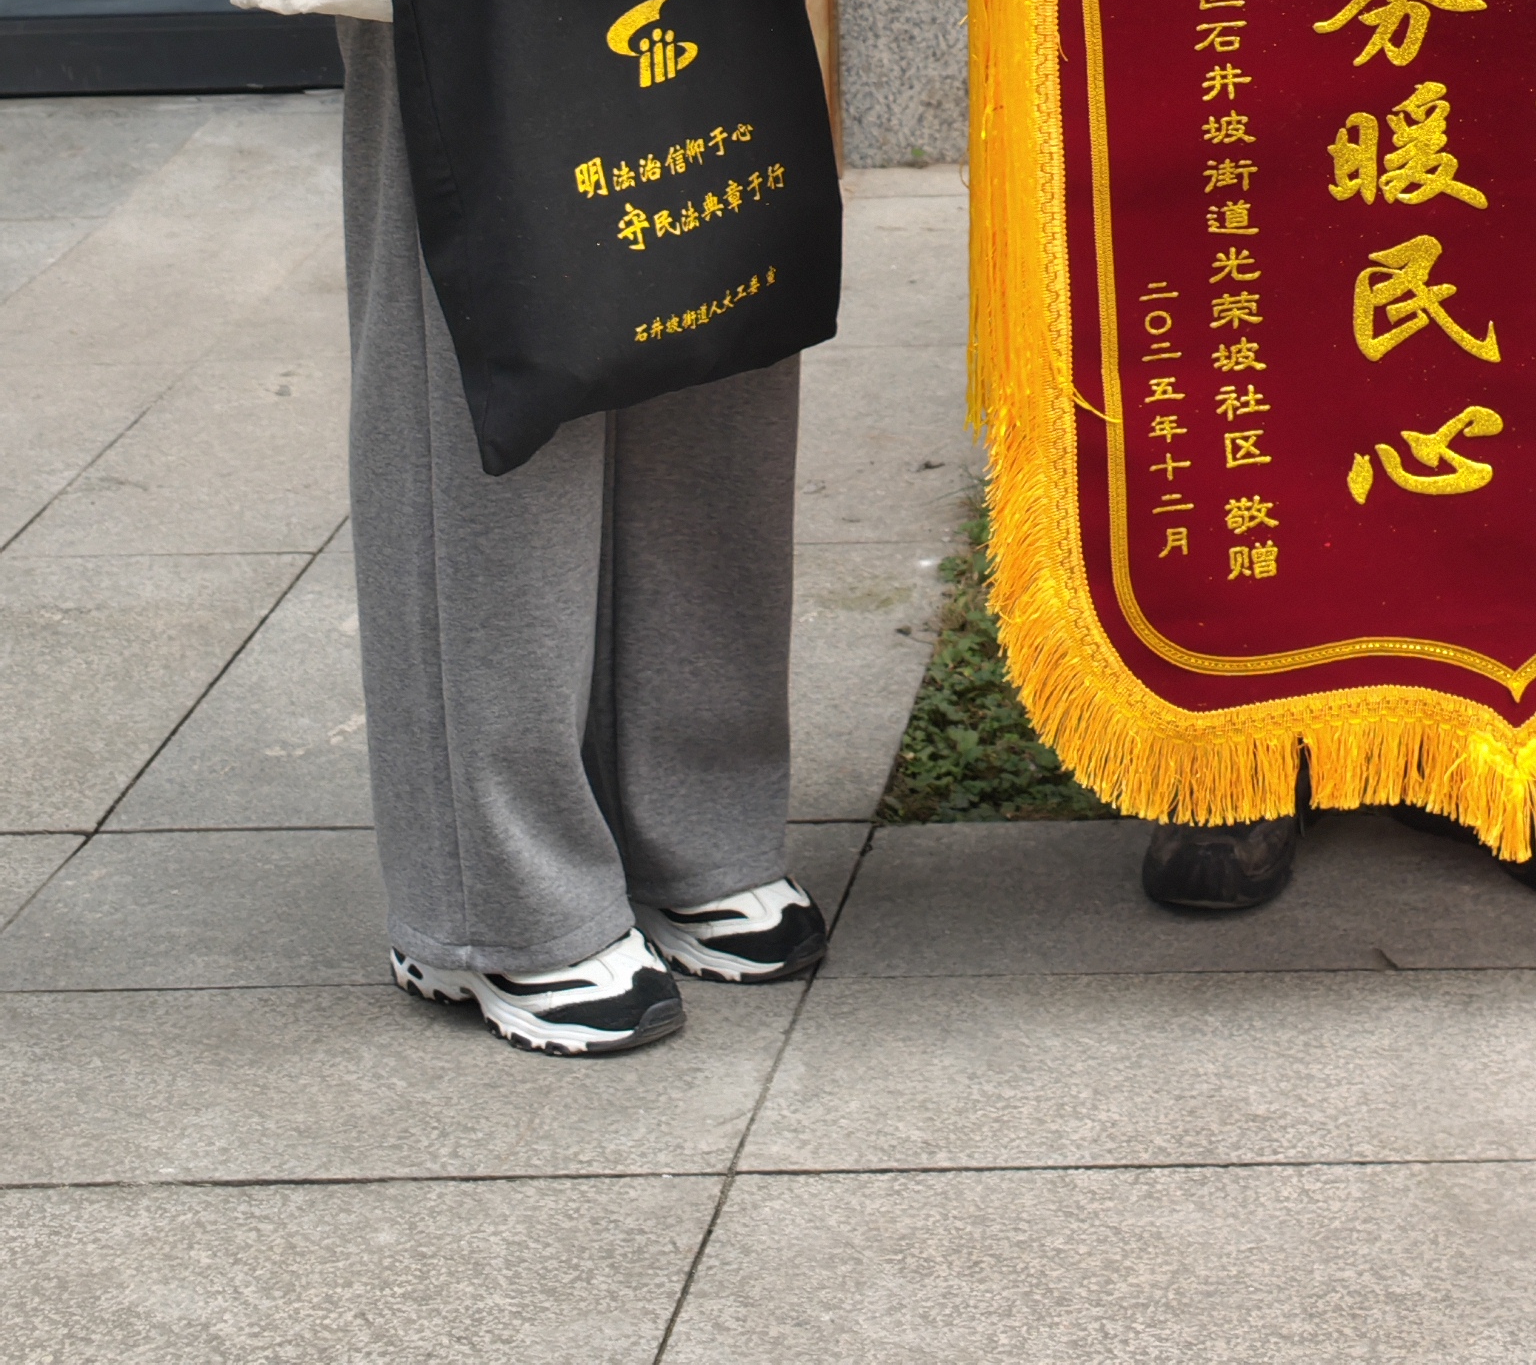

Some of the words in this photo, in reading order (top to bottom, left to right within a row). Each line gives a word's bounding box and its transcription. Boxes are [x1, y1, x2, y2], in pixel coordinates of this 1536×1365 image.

[574, 123, 754, 199] 明法治信仰于心
[617, 163, 785, 251] 守民法典章于行
